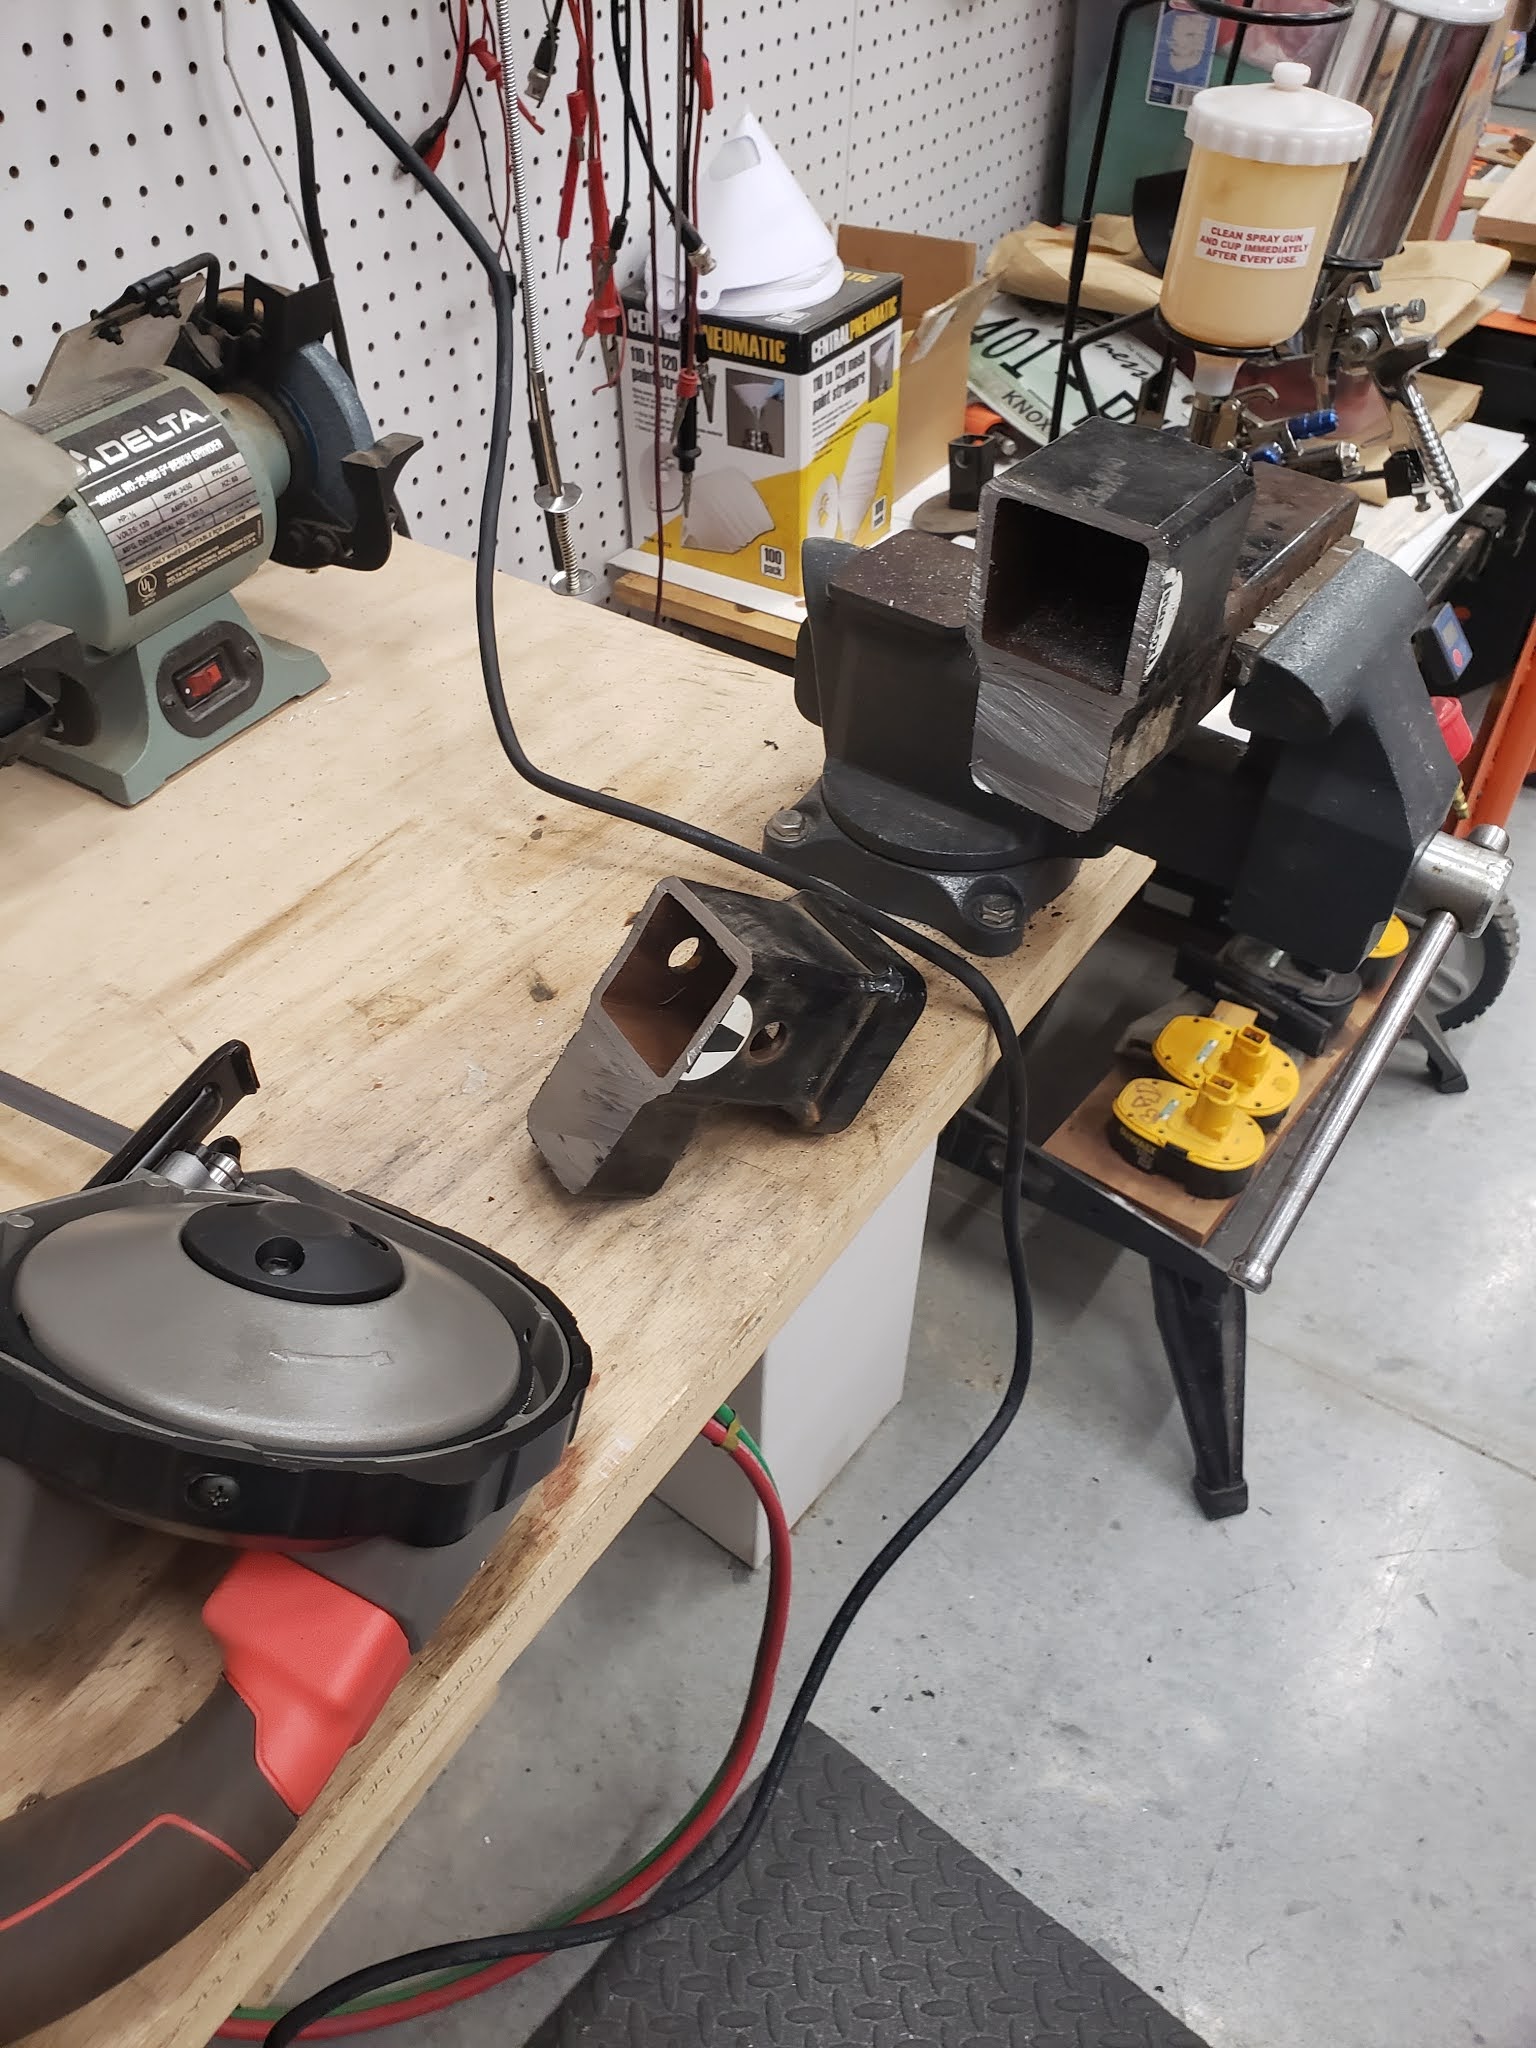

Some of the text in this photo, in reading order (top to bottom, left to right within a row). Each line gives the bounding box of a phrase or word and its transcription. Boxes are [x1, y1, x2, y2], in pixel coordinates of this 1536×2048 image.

[1211, 226, 1304, 243] CLEAN SPRAY GUN
[1200, 235, 1309, 254] AND CUP IMMEDIATELY
[1206, 248, 1297, 264] AFTER EVERY USE.
[702, 325, 786, 365] NEUMATIC
[971, 317, 1062, 379] 401
[661, 353, 678, 372] 120
[1002, 390, 1051, 432] KNOX
[95, 408, 207, 466] DELTA
[95, 486, 125, 506] MODEL
[167, 452, 194, 472] BENCH
[191, 438, 224, 460] GRINDER
[211, 463, 232, 477] PHASE:
[117, 526, 138, 540] VOLTS:
[140, 564, 151, 573] USE
[152, 556, 166, 568] ONLY
[167, 544, 187, 559] WHEELS
[764, 547, 782, 565] 100
